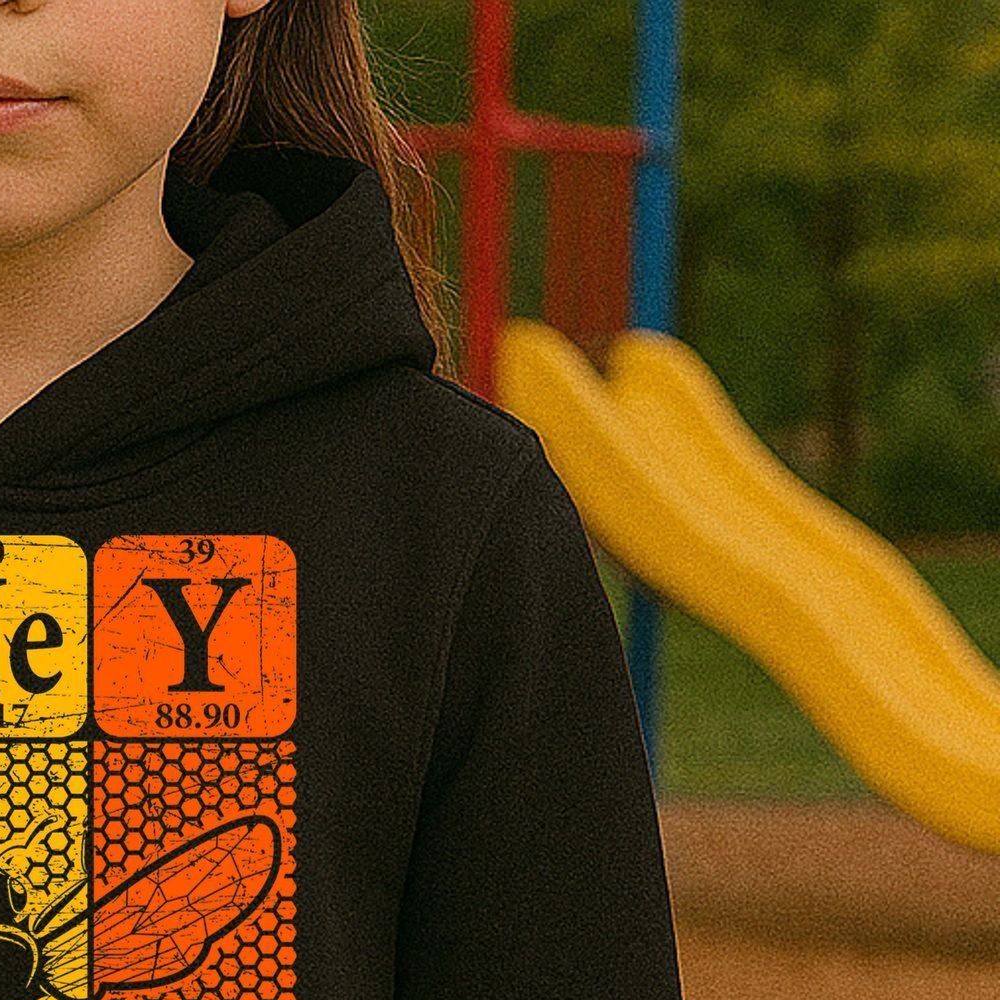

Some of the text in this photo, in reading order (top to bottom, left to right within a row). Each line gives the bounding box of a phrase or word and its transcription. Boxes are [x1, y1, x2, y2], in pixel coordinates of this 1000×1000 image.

[178, 539, 214, 565] 39
[141, 578, 252, 694] Y
[155, 703, 240, 730] 88.90
